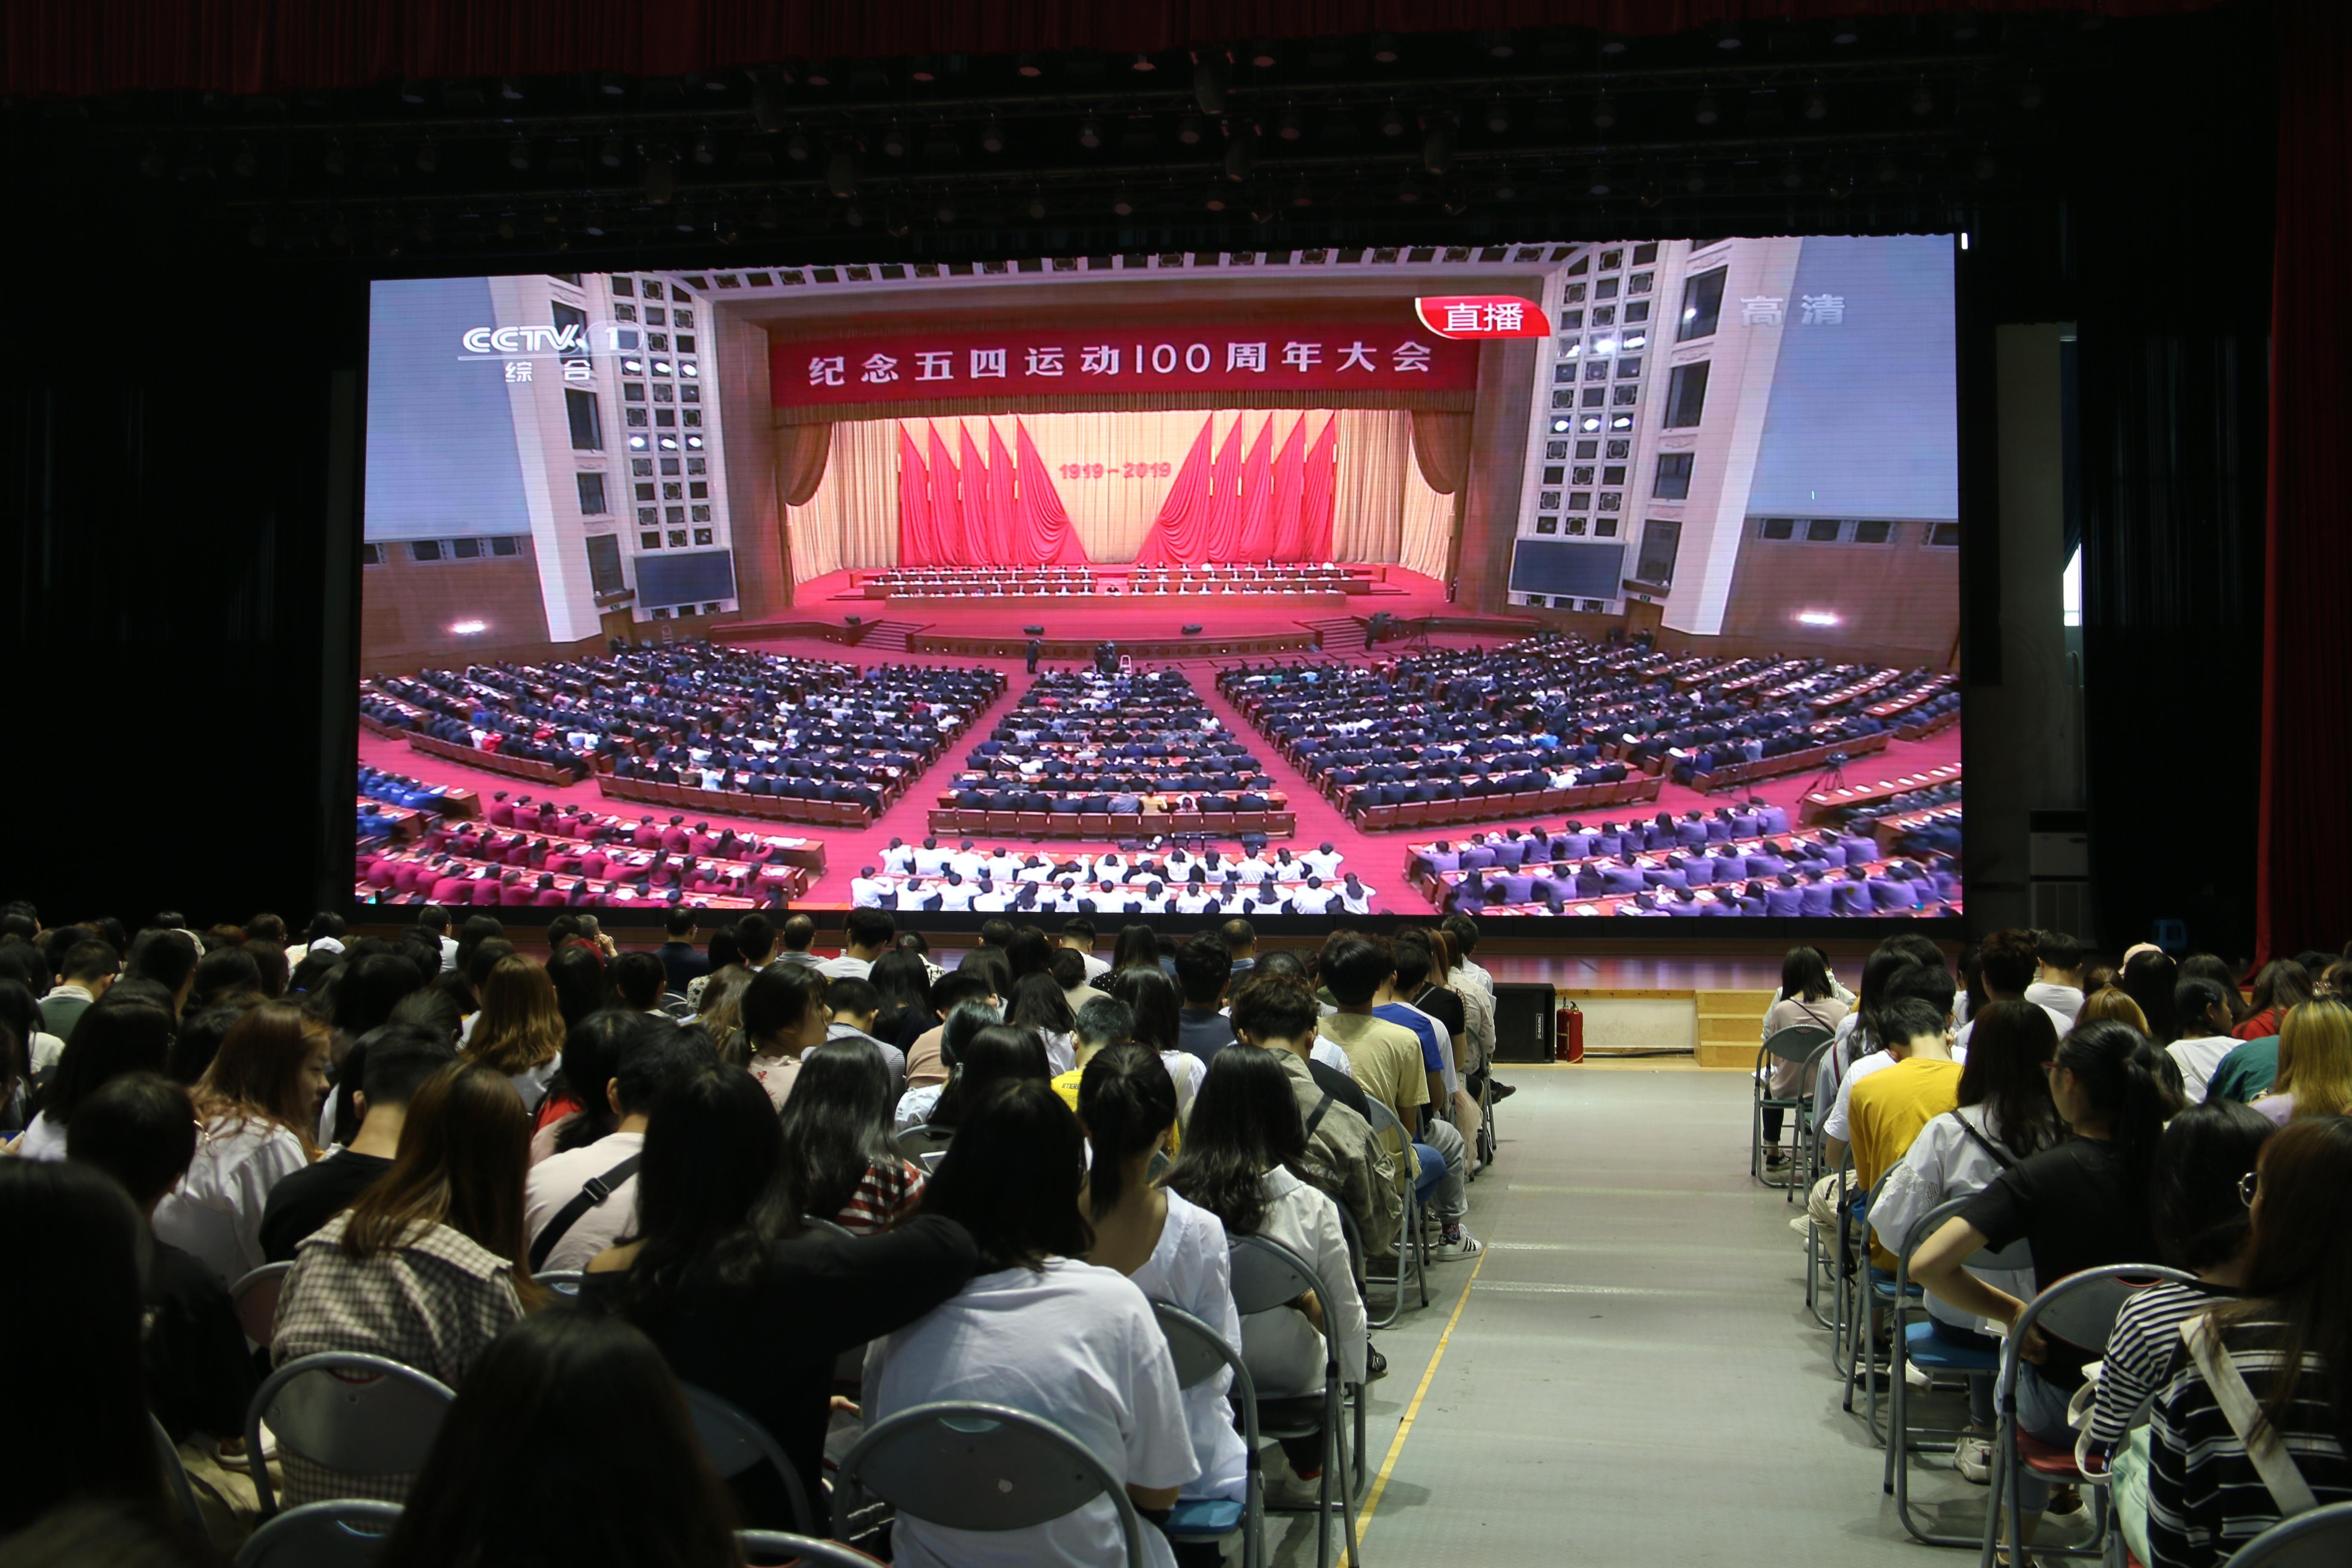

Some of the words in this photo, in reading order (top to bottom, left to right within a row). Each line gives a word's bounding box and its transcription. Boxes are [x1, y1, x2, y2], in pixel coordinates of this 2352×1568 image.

[1442, 302, 1524, 331] 直播
[1740, 294, 1845, 327] 高清
[505, 359, 591, 383] 综合
[808, 341, 1432, 386] 纪念五四运动100周年大会
